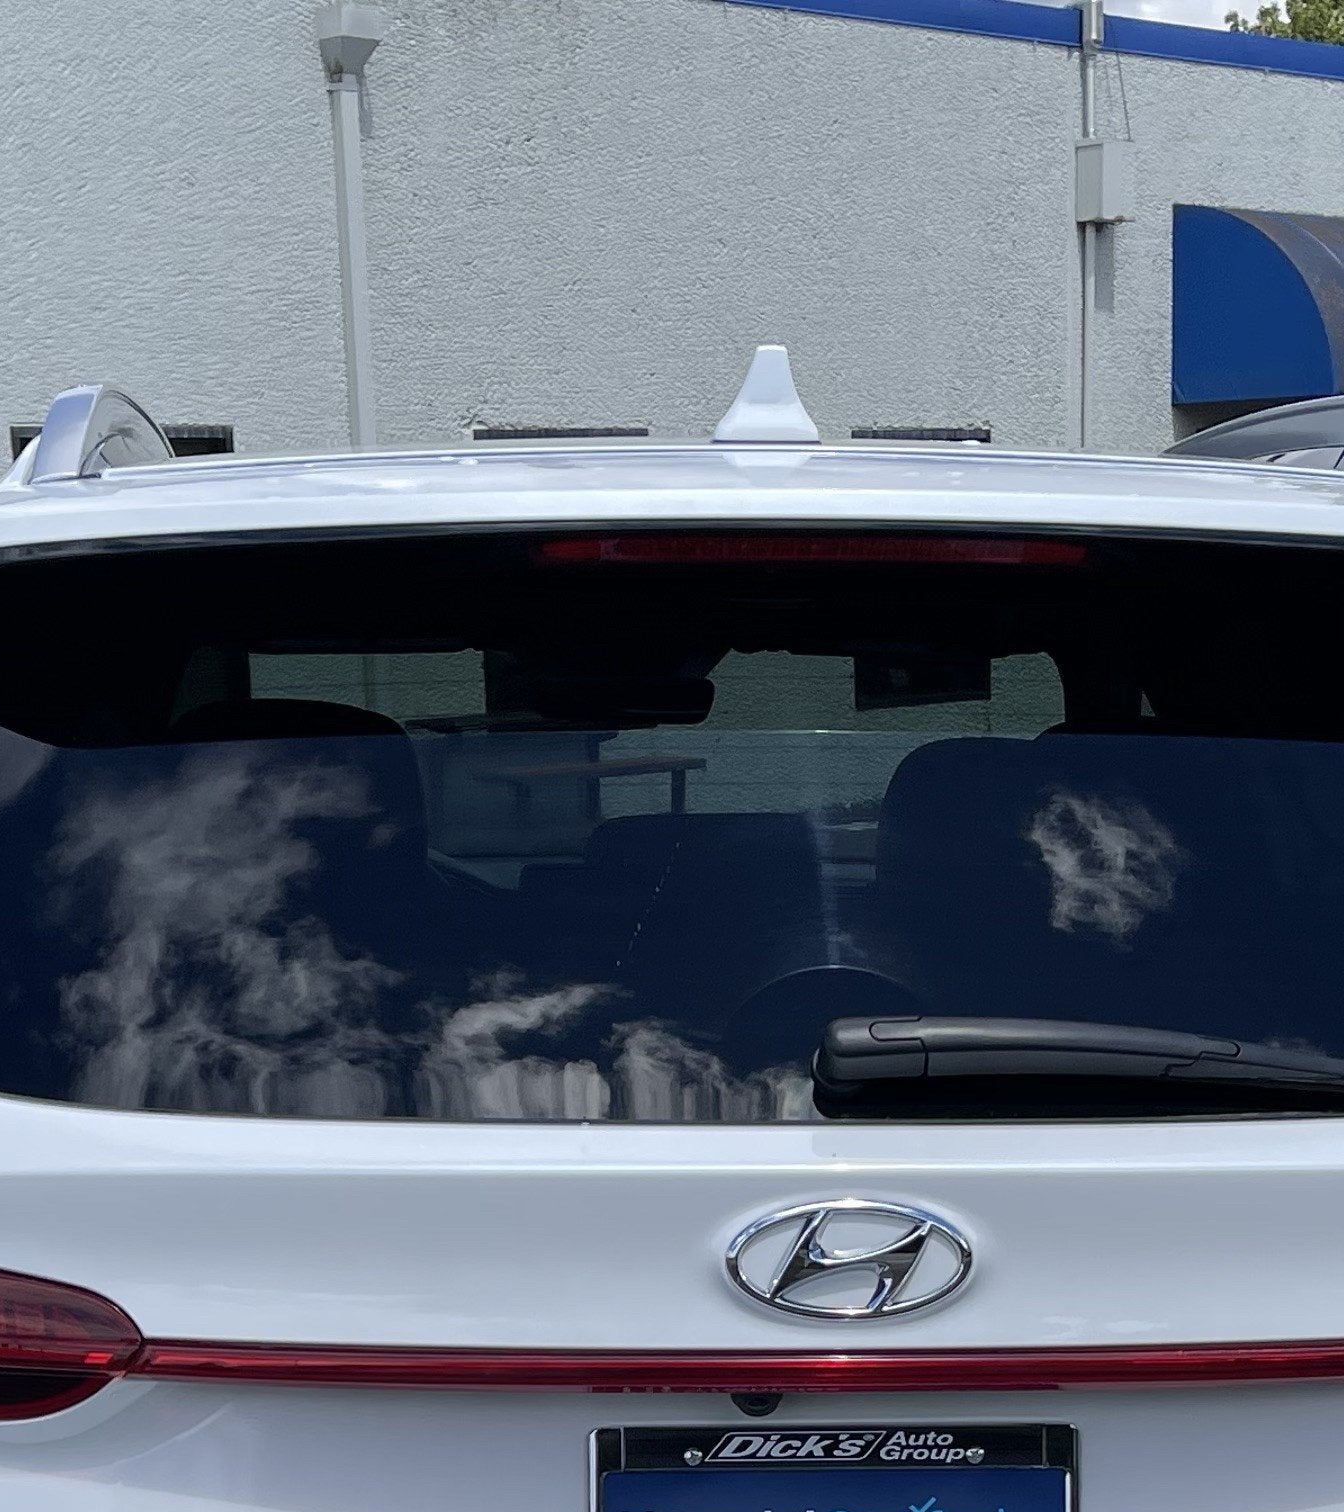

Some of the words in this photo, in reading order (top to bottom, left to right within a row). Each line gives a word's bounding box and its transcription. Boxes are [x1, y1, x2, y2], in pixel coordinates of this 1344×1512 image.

[718, 1435, 867, 1458] Dick's
[886, 1431, 954, 1446] Auto
[879, 1446, 964, 1463] Group
